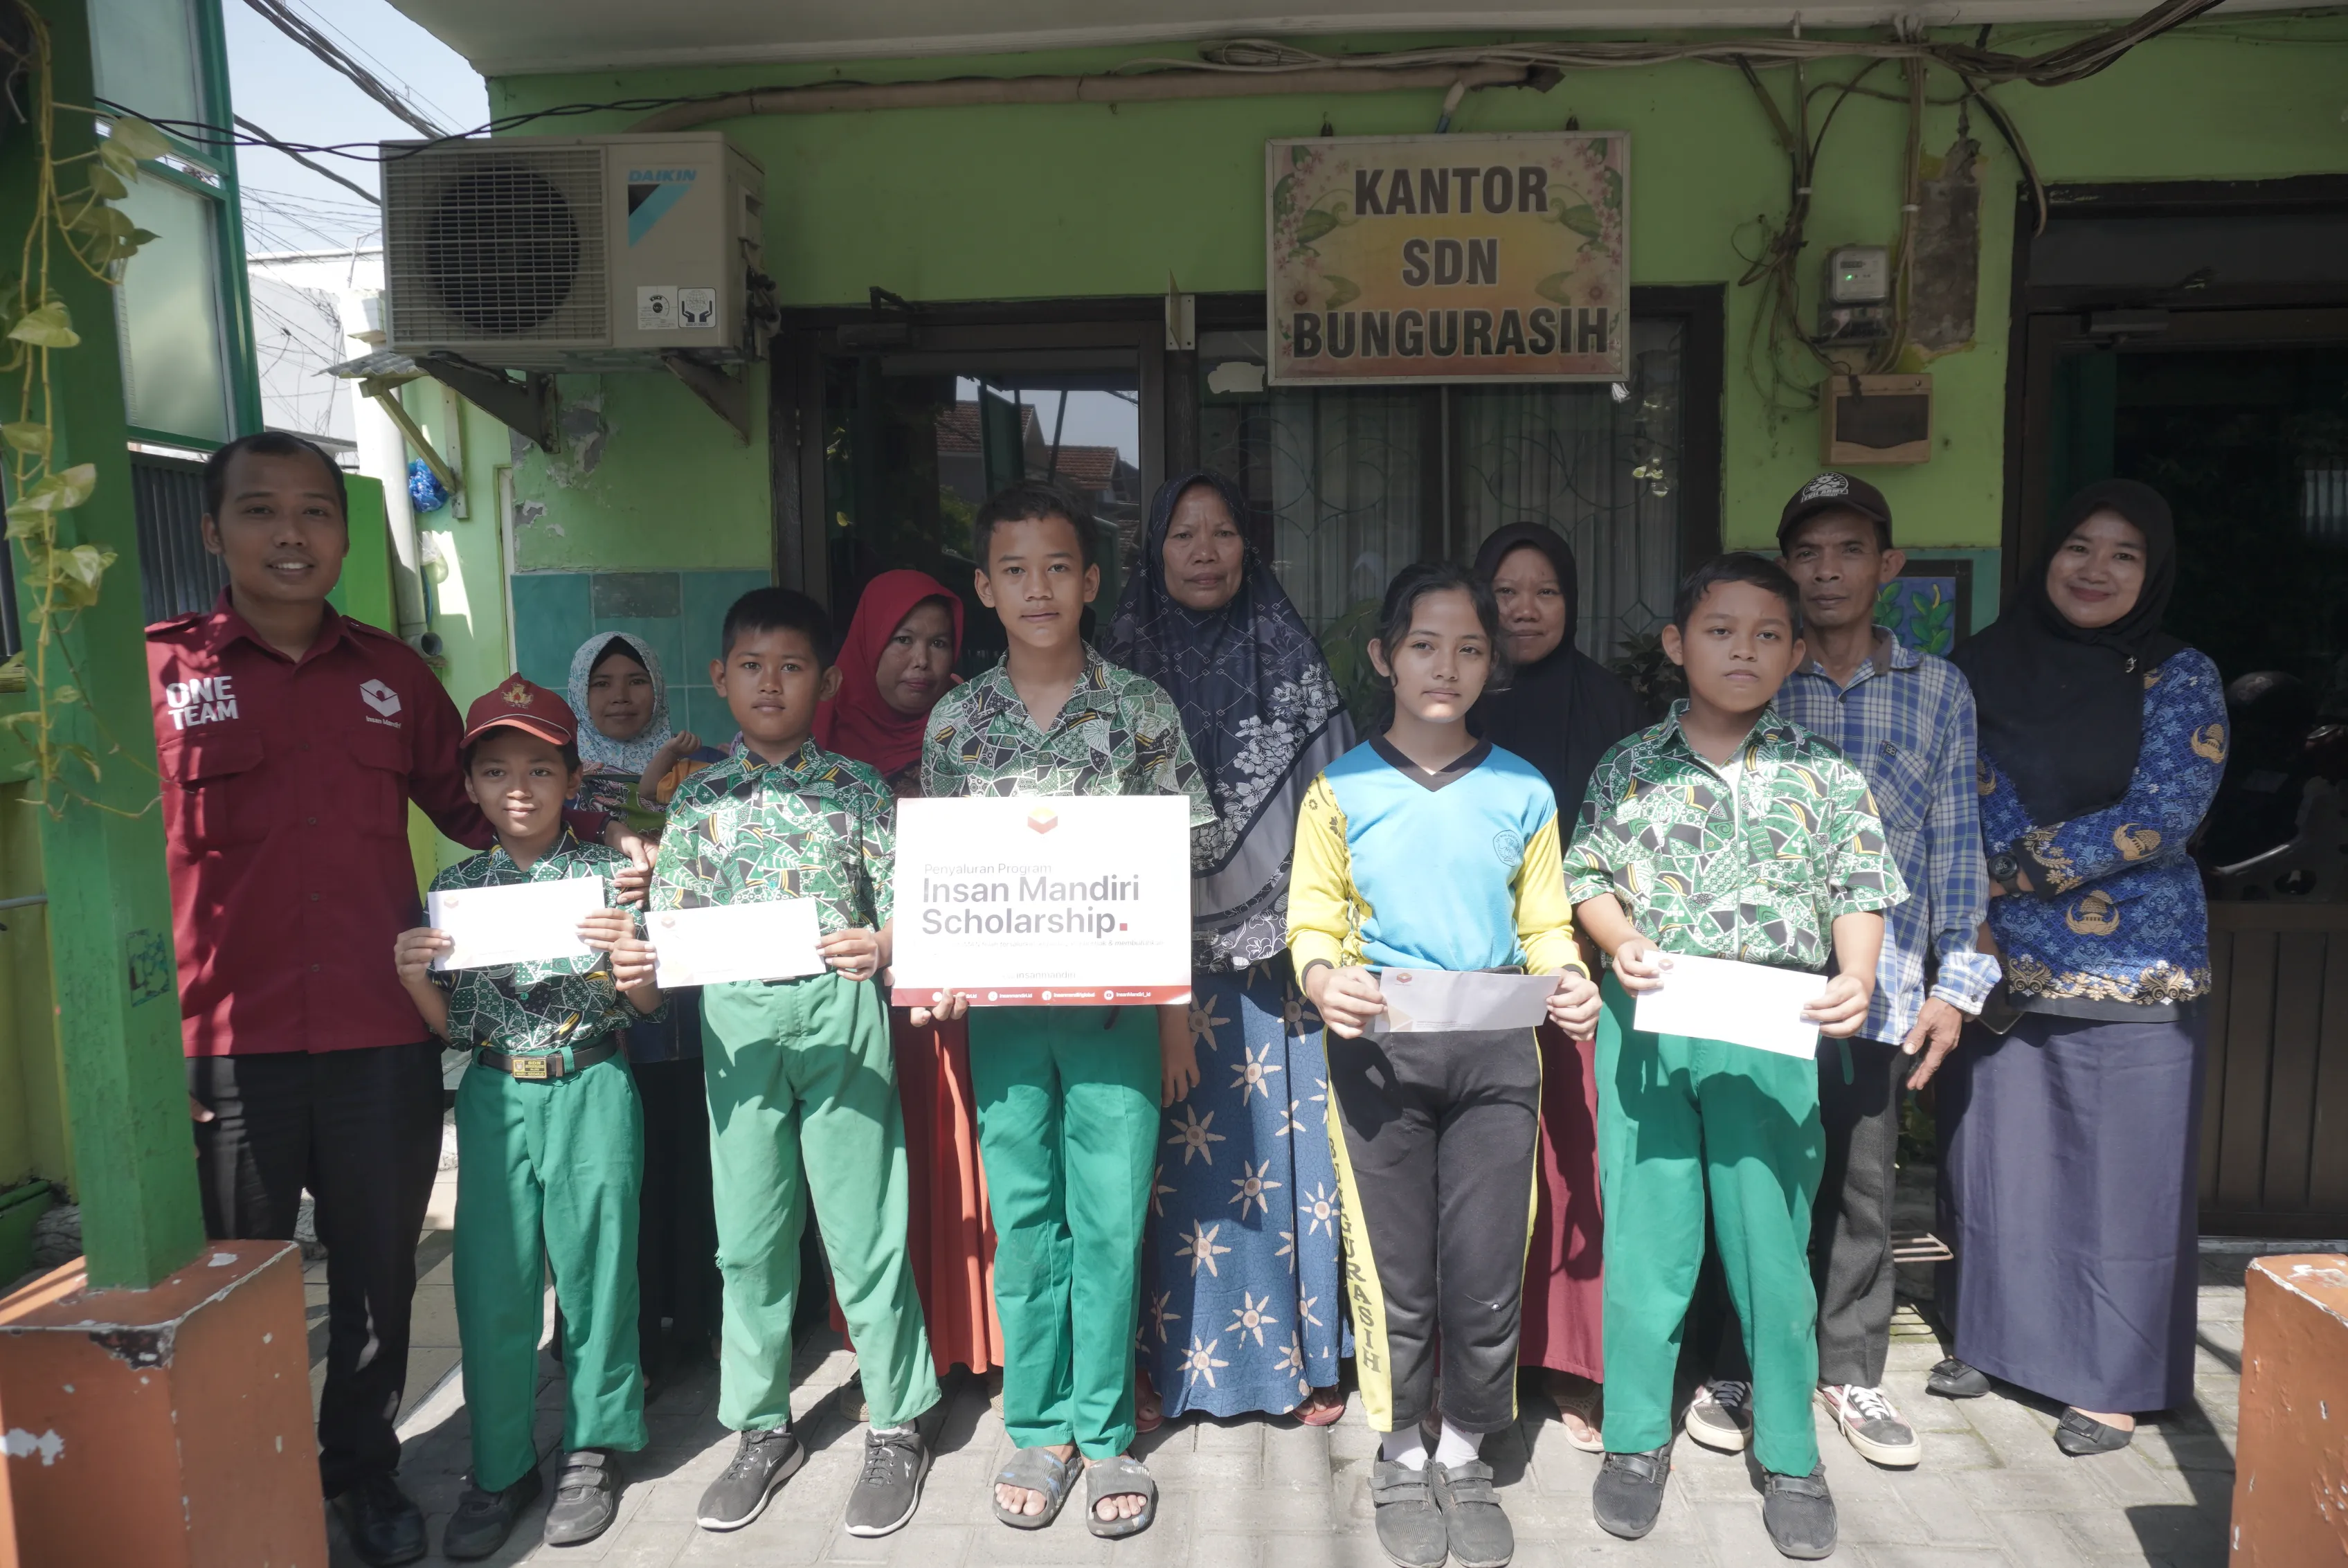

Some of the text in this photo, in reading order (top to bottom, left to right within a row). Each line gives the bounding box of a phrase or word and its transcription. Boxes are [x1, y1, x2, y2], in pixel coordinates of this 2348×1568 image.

[628, 169, 697, 182] DAIKIN
[1355, 165, 1548, 215] KANTOR
[1402, 238, 1499, 287] SDN
[1293, 307, 1609, 359] BUNGURASIH
[166, 675, 236, 709] ONE
[168, 699, 240, 731] TEAM
[925, 863, 1051, 876] Penyaluran Program
[923, 874, 1139, 903] Insan Mandiri
[922, 905, 1128, 939] Scholarship.
